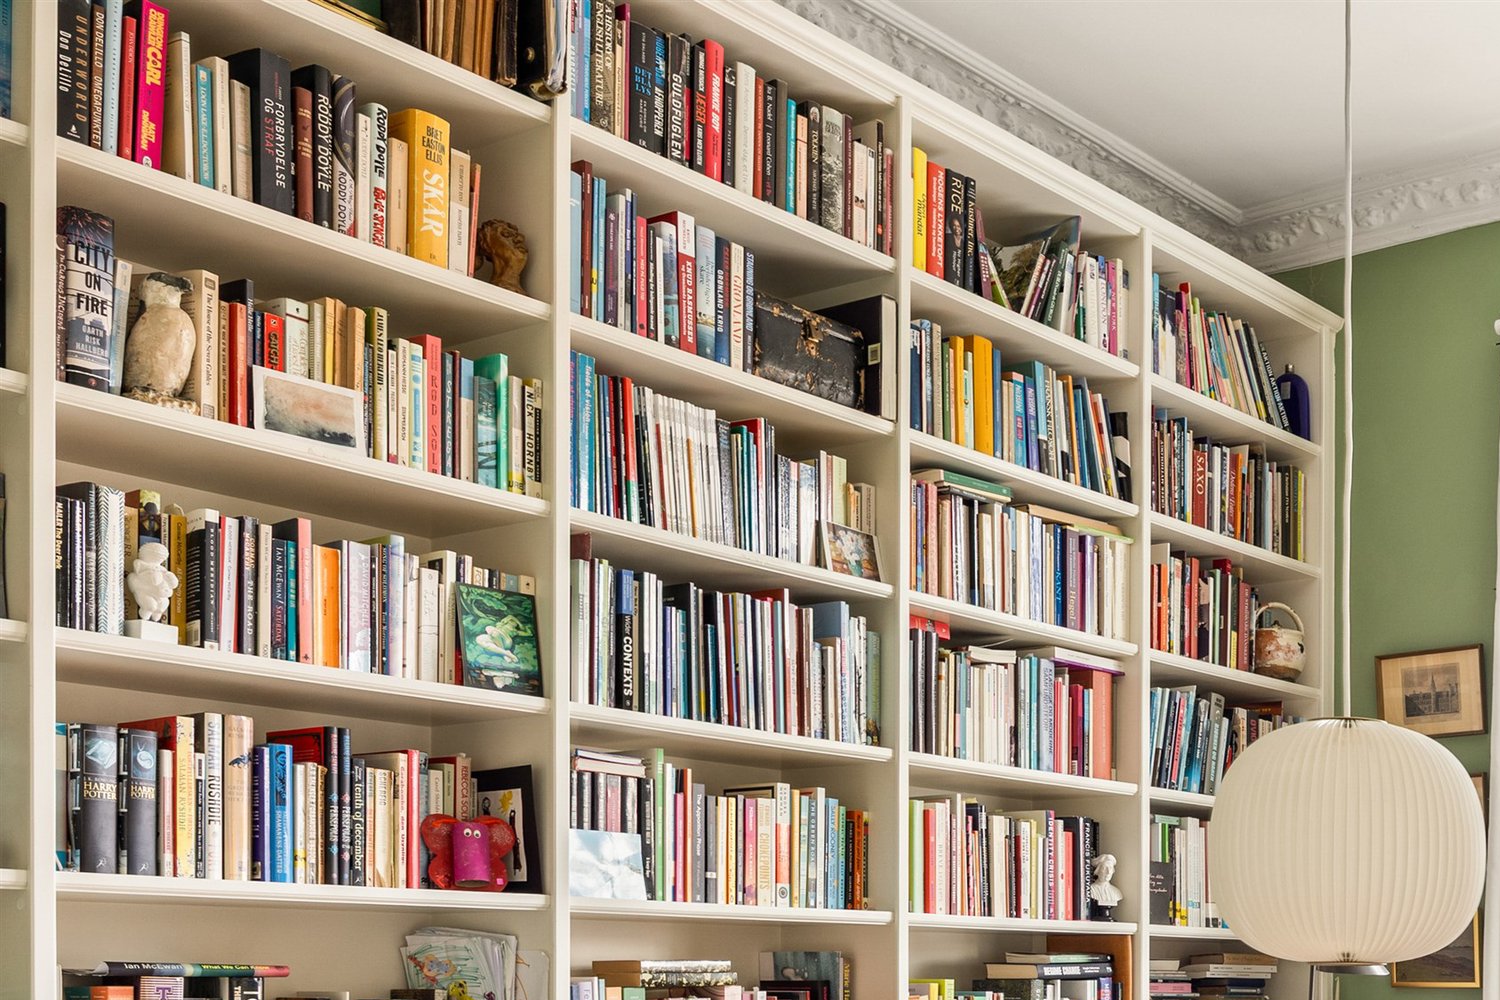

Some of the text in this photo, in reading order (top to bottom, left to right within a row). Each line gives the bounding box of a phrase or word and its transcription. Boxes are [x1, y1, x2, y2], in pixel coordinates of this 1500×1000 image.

[59, 30, 72, 93] Don DeLillo
[596, 1, 606, 108] ENGLISH LITERATURE
[604, 4, 614, 71] A HISTORY OF
[75, 15, 88, 123] UNDERWORLD
[91, 11, 106, 148] DON DELILLO OMEGAPUNKTET
[146, 47, 163, 87] CARL
[263, 98, 276, 157] OG STRAF
[653, 87, 665, 137] AFHOPPEREN
[670, 73, 684, 159] GULDFUGLEN
[695, 91, 707, 125] JÆGER
[710, 73, 722, 134] FRANKIE BOY
[766, 85, 775, 177] Ira B. Nadel Leonard Cohen
[149, 122, 157, 144] MATT
[276, 102, 288, 189] FORBRYDELSE
[317, 94, 330, 193] RODDY DOYLE
[373, 107, 387, 179] RODDY DOYLE
[425, 148, 443, 166] ELLIS
[811, 129, 819, 164] TOLKIEN
[336, 171, 349, 235] RODDY DOYLE
[420, 168, 446, 237] SKÅR
[916, 198, 925, 237] mandat
[936, 170, 945, 268] MOGENS LYKKETOFT
[951, 177, 962, 215] RICE
[966, 200, 976, 257] Kushner, Inc.
[74, 241, 113, 274] CITY
[84, 270, 102, 292] ON
[745, 252, 755, 296] STAUNING OG
[75, 293, 109, 318] FIRE
[206, 305, 214, 325] House
[206, 325, 214, 333] of
[686, 260, 695, 344] KNUD RASMUSSEN
[733, 274, 743, 344] GRØNLAND
[81, 324, 105, 339] GARTH
[85, 335, 102, 348] RISK
[205, 344, 214, 363] Seven
[206, 333, 214, 344] the
[204, 363, 213, 387] Gables
[1261, 352, 1290, 427] AKTION AKTION AKTION
[583, 389, 593, 423] of vision
[526, 390, 536, 481] NICK HORNBY
[1195, 455, 1205, 495] SAXO
[55, 501, 64, 570] MAILER The Deer Park
[246, 579, 255, 636] THE ROAD
[275, 546, 286, 644] IAN SATURDAY
[360, 588, 369, 627] MITCHELL
[1068, 590, 1077, 619] Hegel
[623, 615, 634, 697] Wider CONTEXTS
[1046, 668, 1054, 755] KLASSISK OG MODERNE
[83, 781, 118, 792] HARRY
[83, 790, 118, 800] POTTER
[207, 721, 222, 826] SALMAN RUSHDIE
[460, 765, 470, 800] REBECCA
[275, 804, 284, 875] SHAMANENS DATTER
[328, 805, 338, 842] PERSEPOLIS
[342, 805, 351, 843] PERSEPOLIS
[351, 783, 365, 872] tenth of december
[694, 793, 703, 857] The Apparition Phase
[1047, 817, 1055, 887] IDENTITY CRISIS
[759, 832, 771, 890] CHOKEPOINTS
[1083, 822, 1092, 904] FRANCIS FUKUYAMA
[124, 962, 184, 970] Ian McEwan
[843, 963, 851, 988] Marie
